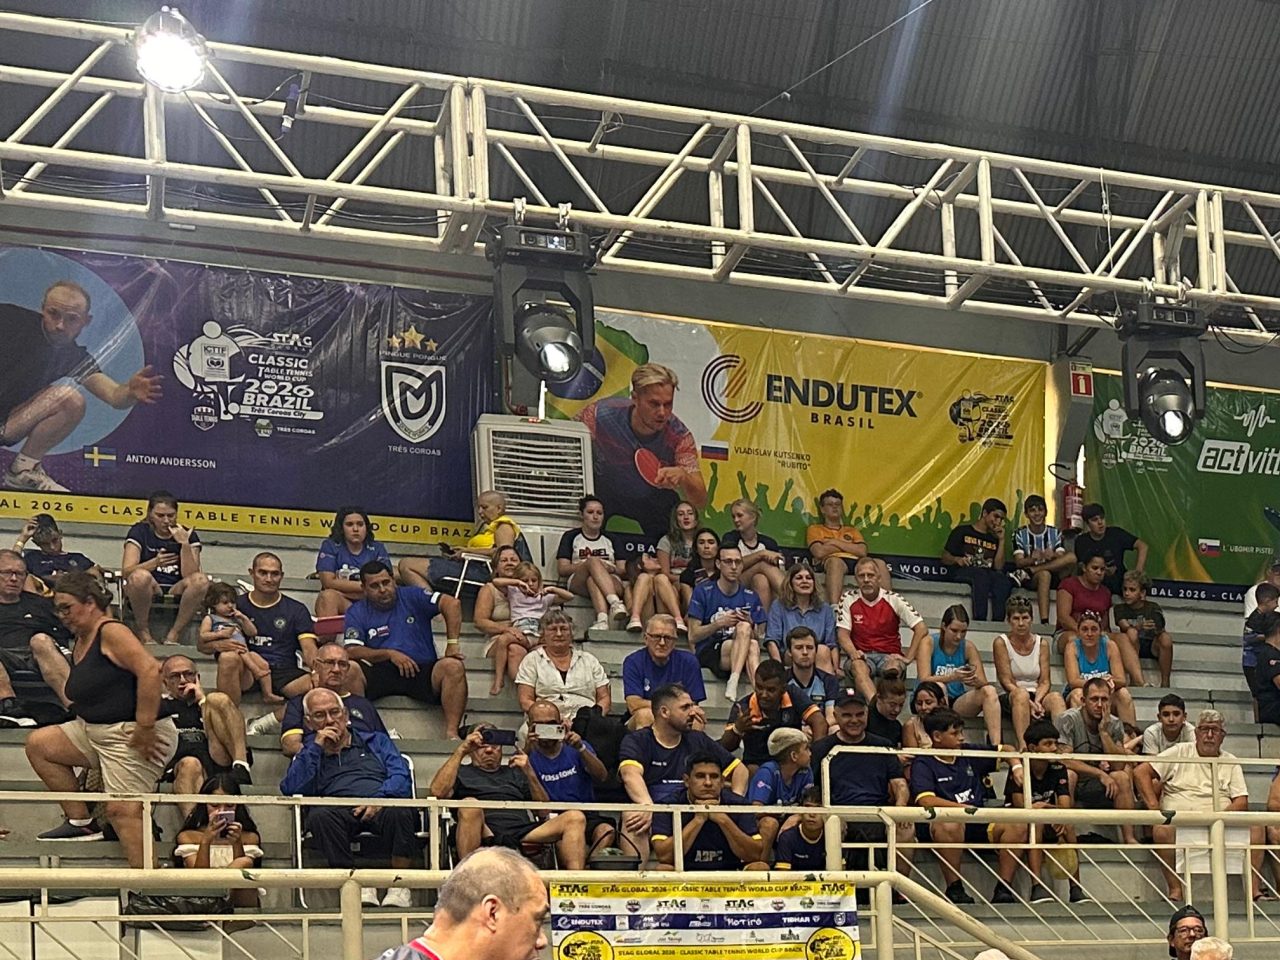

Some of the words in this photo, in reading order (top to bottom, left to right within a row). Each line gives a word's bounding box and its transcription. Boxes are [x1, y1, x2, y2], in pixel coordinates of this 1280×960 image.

[272, 333, 313, 346] STAG
[249, 354, 308, 369] CLASSIC
[264, 374, 290, 382] WORLD
[286, 368, 313, 377] TENNIS
[245, 378, 314, 397] 2026
[243, 393, 312, 410] BRAZIL
[766, 373, 917, 418] ENDUTEX
[811, 412, 874, 429] BRASIL
[409, 446, 441, 456] COROAS
[734, 446, 772, 457] VLADISLAV
[774, 450, 811, 461] KUTSENKO
[1129, 445, 1167, 457] BRAZIL
[125, 454, 158, 465] ANTON
[160, 457, 216, 468] ANDERSSON
[31, 500, 74, 512] 2026
[100, 504, 144, 516] CLAS
[185, 510, 239, 522] TABLE
[249, 514, 311, 527] TENNIS
[390, 524, 421, 534] CUP
[430, 527, 472, 538] BRAZ
[900, 564, 948, 575] WORLD
[1179, 589, 1206, 599] 2026
[657, 899, 686, 908] STAG
[725, 899, 754, 908] STAG
